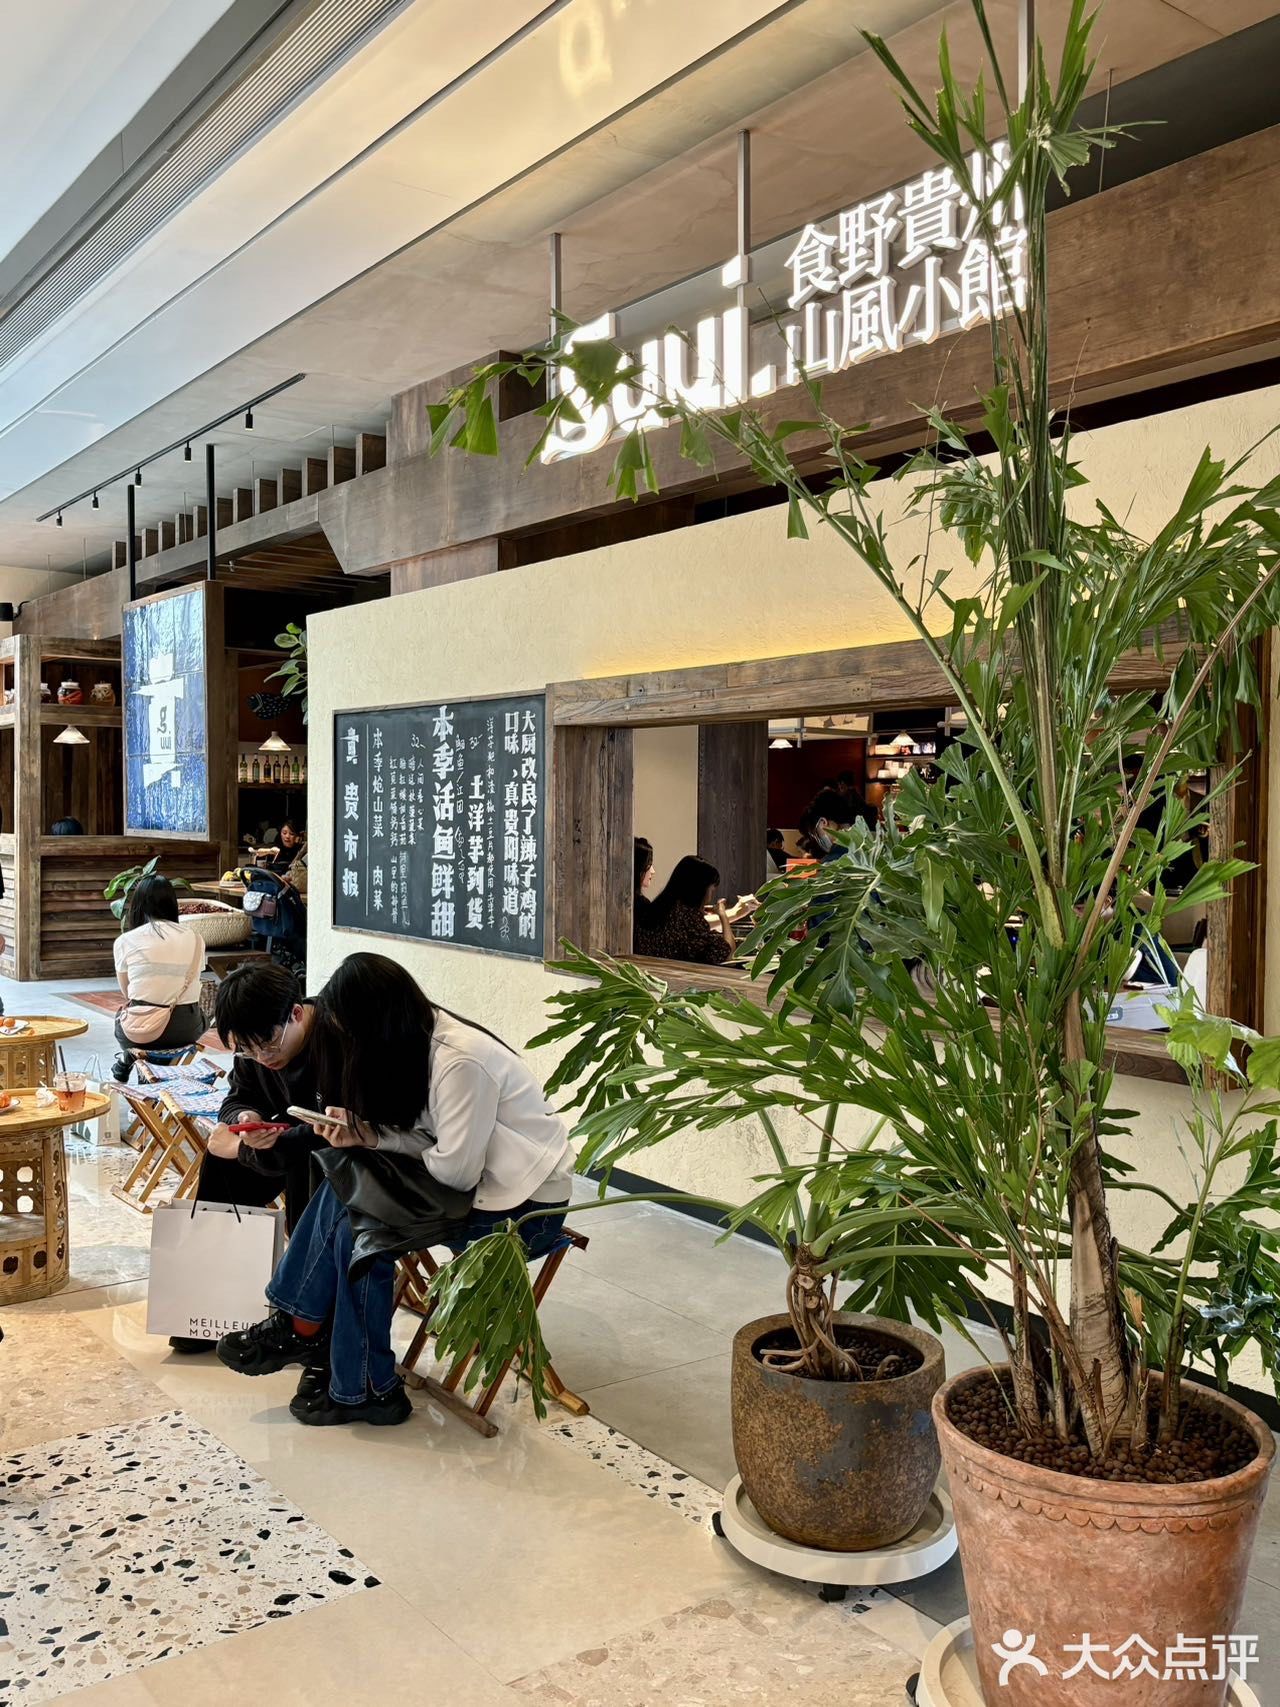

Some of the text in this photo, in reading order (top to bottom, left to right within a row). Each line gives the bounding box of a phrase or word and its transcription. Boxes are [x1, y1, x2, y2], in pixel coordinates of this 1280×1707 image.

[787, 226, 1027, 386] 山風小館
[431, 705, 456, 938] 本季活鱼鲜甜
[465, 774, 486, 931] 土洋芋到货
[518, 710, 538, 940] 大厨改良了辣子鸡的
[189, 1329, 225, 1338] MOM
